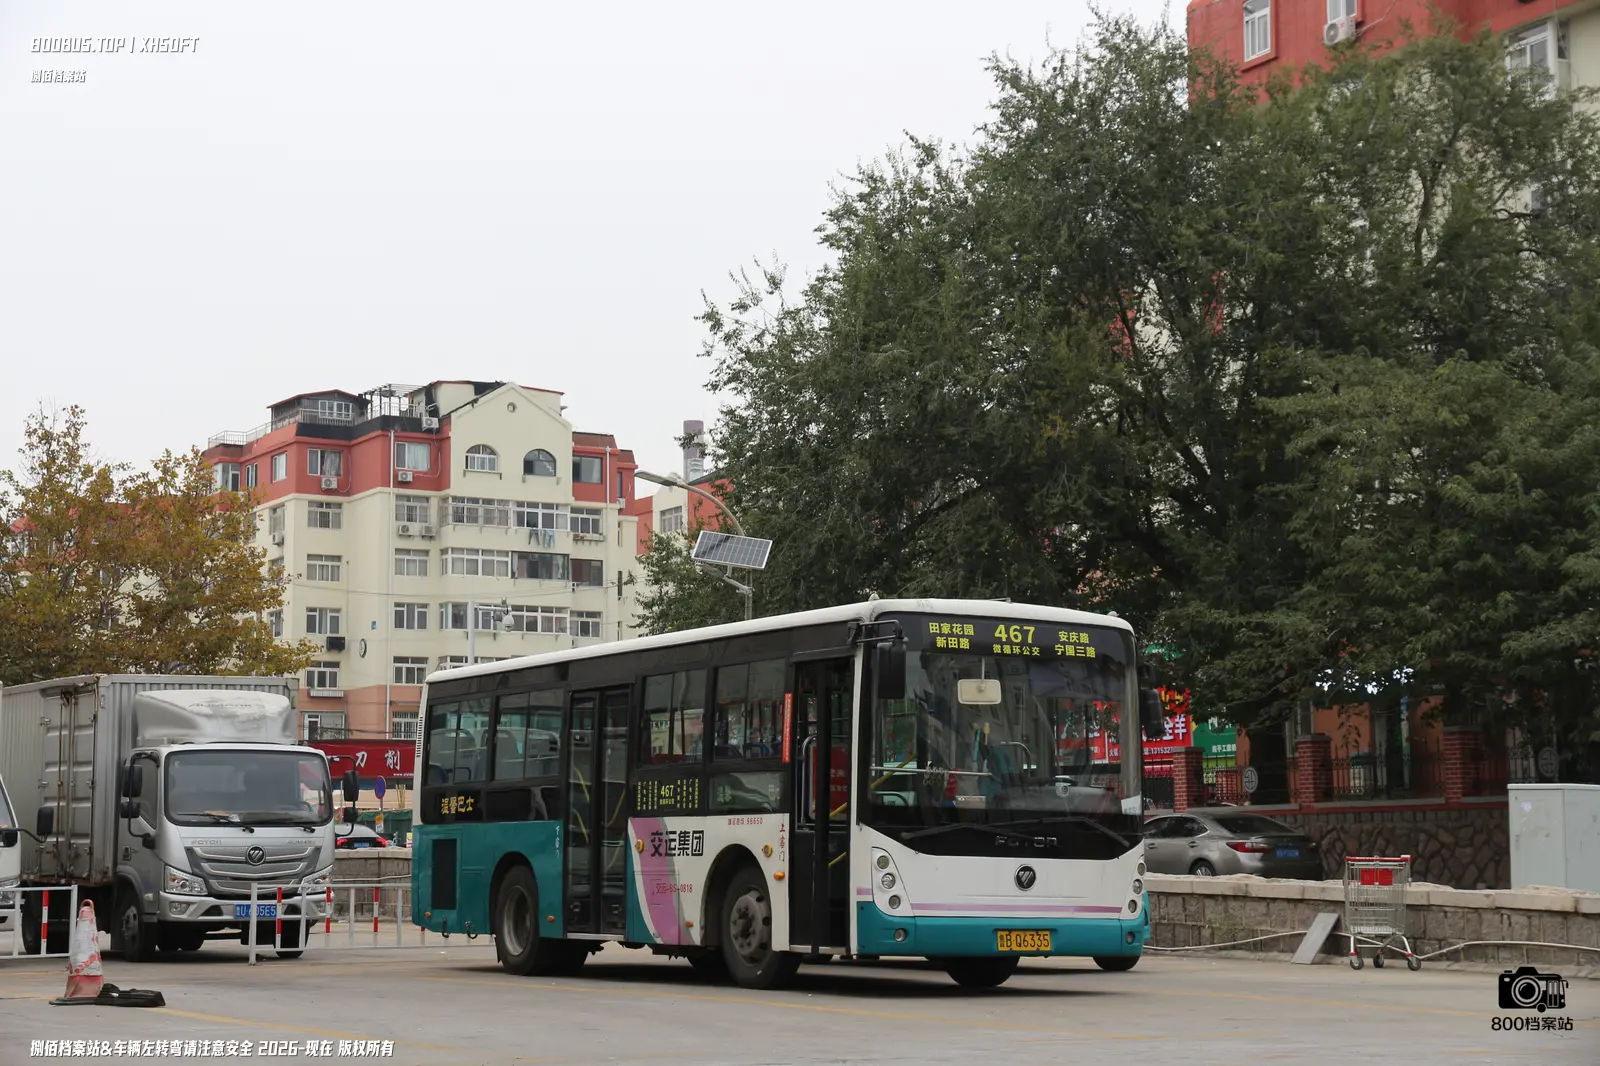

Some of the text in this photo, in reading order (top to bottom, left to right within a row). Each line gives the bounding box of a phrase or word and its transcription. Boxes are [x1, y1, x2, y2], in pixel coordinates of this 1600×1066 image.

[928, 622, 975, 636] 田家花园
[994, 624, 1036, 643] 467
[935, 636, 970, 650] 新田路
[1058, 630, 1090, 644] 安庆路
[992, 643, 1041, 656] 微循环公交
[1054, 644, 1096, 658] 宁国三路
[660, 785, 675, 797] 467
[650, 830, 705, 857] 交运集团
